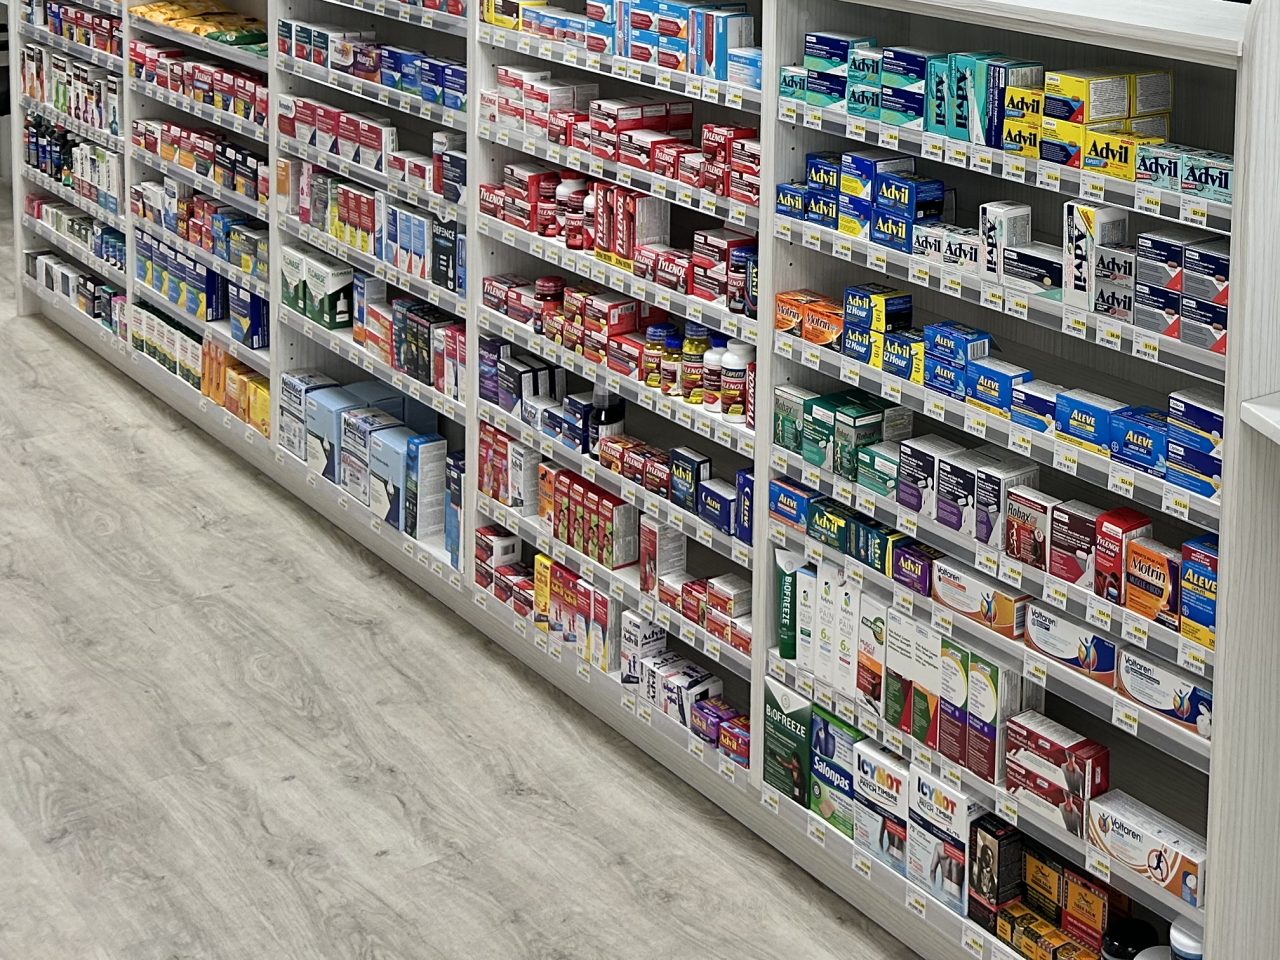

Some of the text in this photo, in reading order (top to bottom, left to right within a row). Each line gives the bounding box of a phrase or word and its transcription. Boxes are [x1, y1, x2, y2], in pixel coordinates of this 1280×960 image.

[850, 57, 879, 75] Advil
[780, 75, 806, 90] Advil
[850, 91, 879, 108] Advil
[1006, 95, 1040, 114] Advil
[703, 128, 725, 144] TYLENOL
[1004, 128, 1037, 148] Advil
[1088, 140, 1129, 164] Advil
[1137, 155, 1178, 178] Advil
[809, 167, 837, 187] Advil
[1184, 166, 1229, 189] Advil
[480, 188, 504, 206] TYLENOL
[777, 191, 802, 210] Advil
[880, 184, 909, 204] Advil
[809, 199, 837, 219] Advil
[876, 217, 906, 240] Advil
[914, 234, 941, 253] Advil
[944, 241, 978, 263] Advil
[986, 217, 997, 274] Advil
[658, 257, 686, 278] TYLENOL
[1073, 224, 1087, 292] Advil
[1097, 254, 1133, 277] Advil
[484, 280, 506, 300] TYLENOL
[847, 295, 869, 308] Advil
[1097, 289, 1133, 311] Advil
[807, 311, 831, 330] Motrin
[847, 306, 867, 318] 12 Hour
[845, 340, 867, 354] 12 Hour
[846, 330, 869, 345] Advil
[935, 334, 955, 349] ALEVE
[883, 340, 910, 359] Advil
[883, 353, 907, 368] 12 Hour
[935, 365, 955, 380] ALEVE
[979, 376, 999, 391] ALEVE
[1072, 409, 1095, 427] ALEVE
[1125, 431, 1153, 449] ALEVE
[646, 462, 667, 480] TYLENOL
[671, 463, 692, 480] Advil
[779, 494, 798, 508] ALEVE
[1007, 503, 1031, 522] Robax
[813, 511, 838, 534] Advil
[1096, 534, 1120, 554] TYLENOL
[898, 556, 922, 576] Advil
[937, 565, 960, 583] Voltaren
[1131, 557, 1167, 584] Motrin
[1184, 568, 1217, 592] ALEVE
[1031, 607, 1056, 627] Voltaren
[1124, 655, 1152, 675] Voltaren
[720, 732, 737, 752] Advil
[813, 755, 850, 791] Salonpas
[1110, 816, 1141, 842] Voltaren
